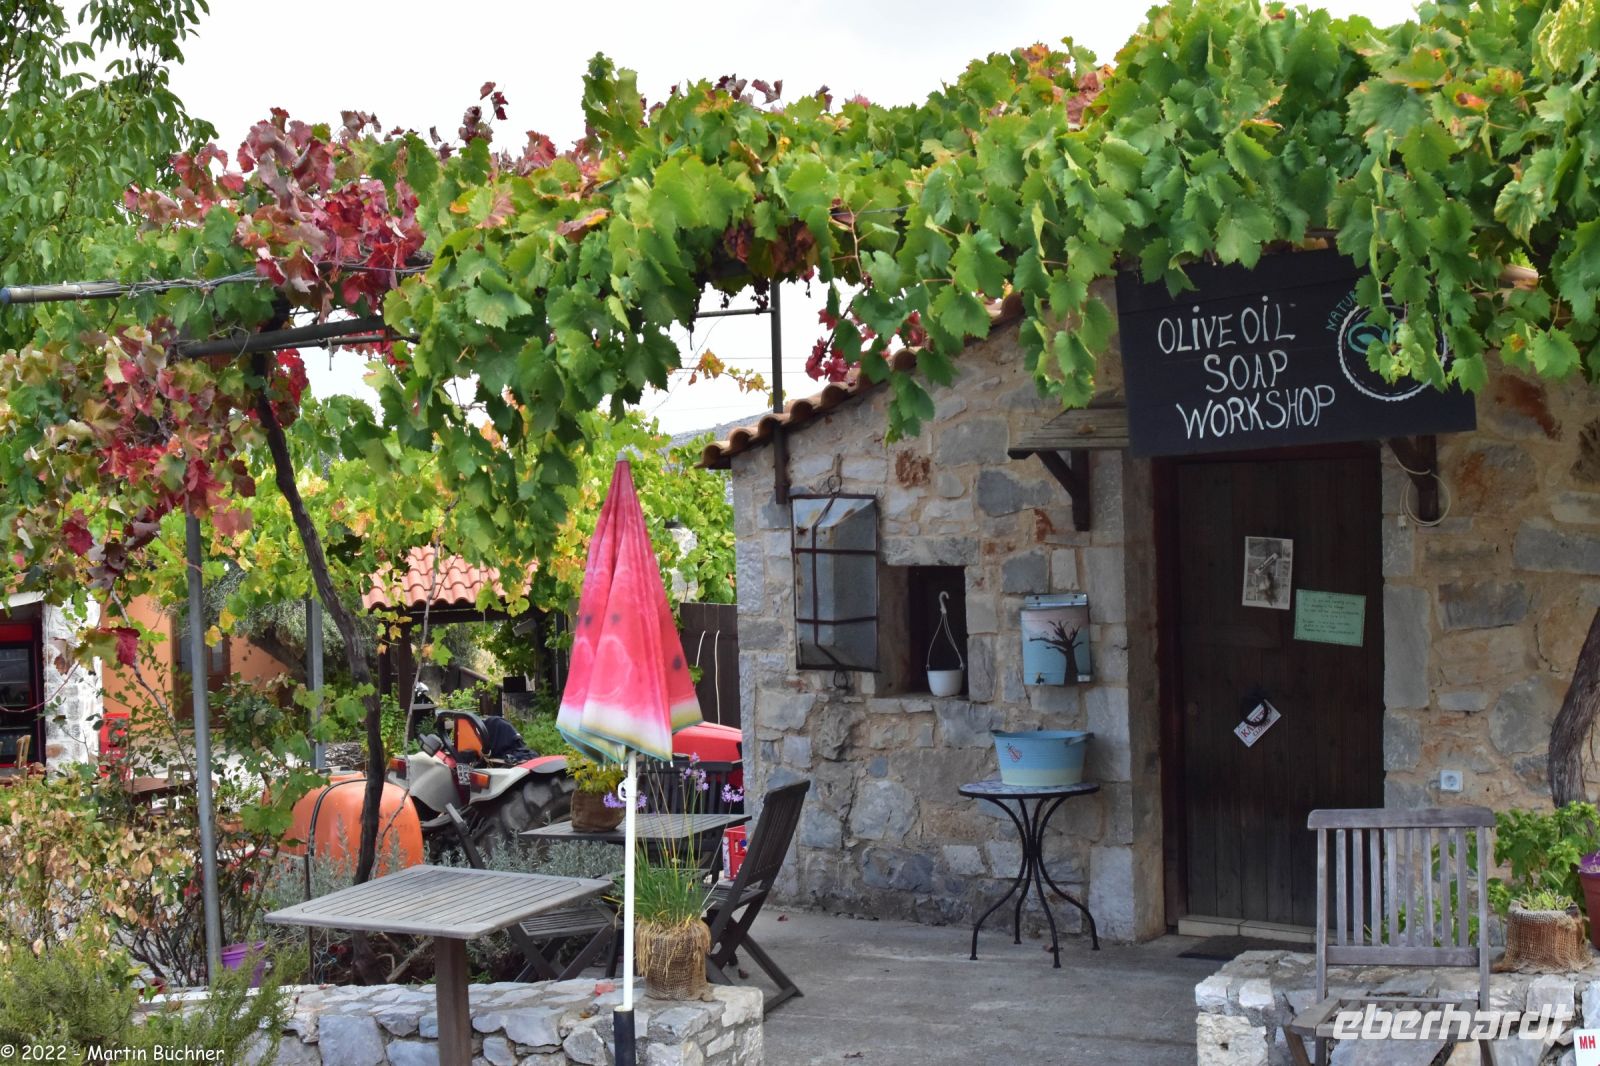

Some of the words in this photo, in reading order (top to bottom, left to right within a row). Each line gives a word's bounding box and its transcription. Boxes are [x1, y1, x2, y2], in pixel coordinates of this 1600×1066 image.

[1325, 290, 1358, 332] NATUR
[1203, 349, 1288, 393] SOAP
[1176, 384, 1336, 440] WORKSHOP
